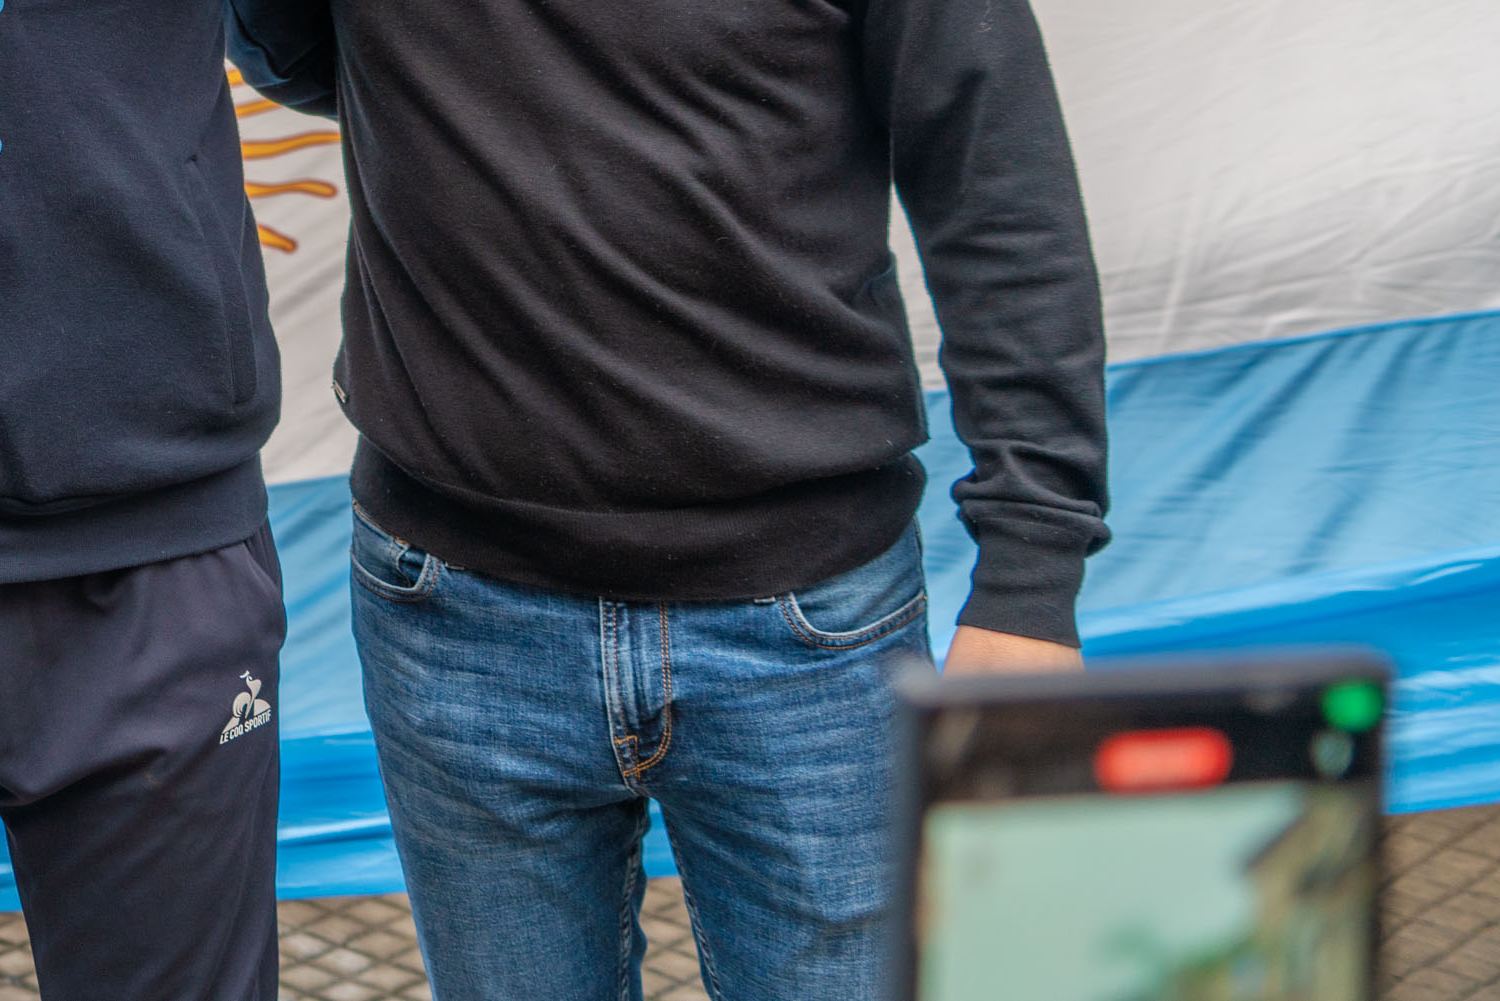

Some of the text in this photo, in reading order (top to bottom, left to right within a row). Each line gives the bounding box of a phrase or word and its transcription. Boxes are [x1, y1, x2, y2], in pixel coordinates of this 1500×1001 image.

[219, 709, 271, 745] LE COQ SPORTIF
